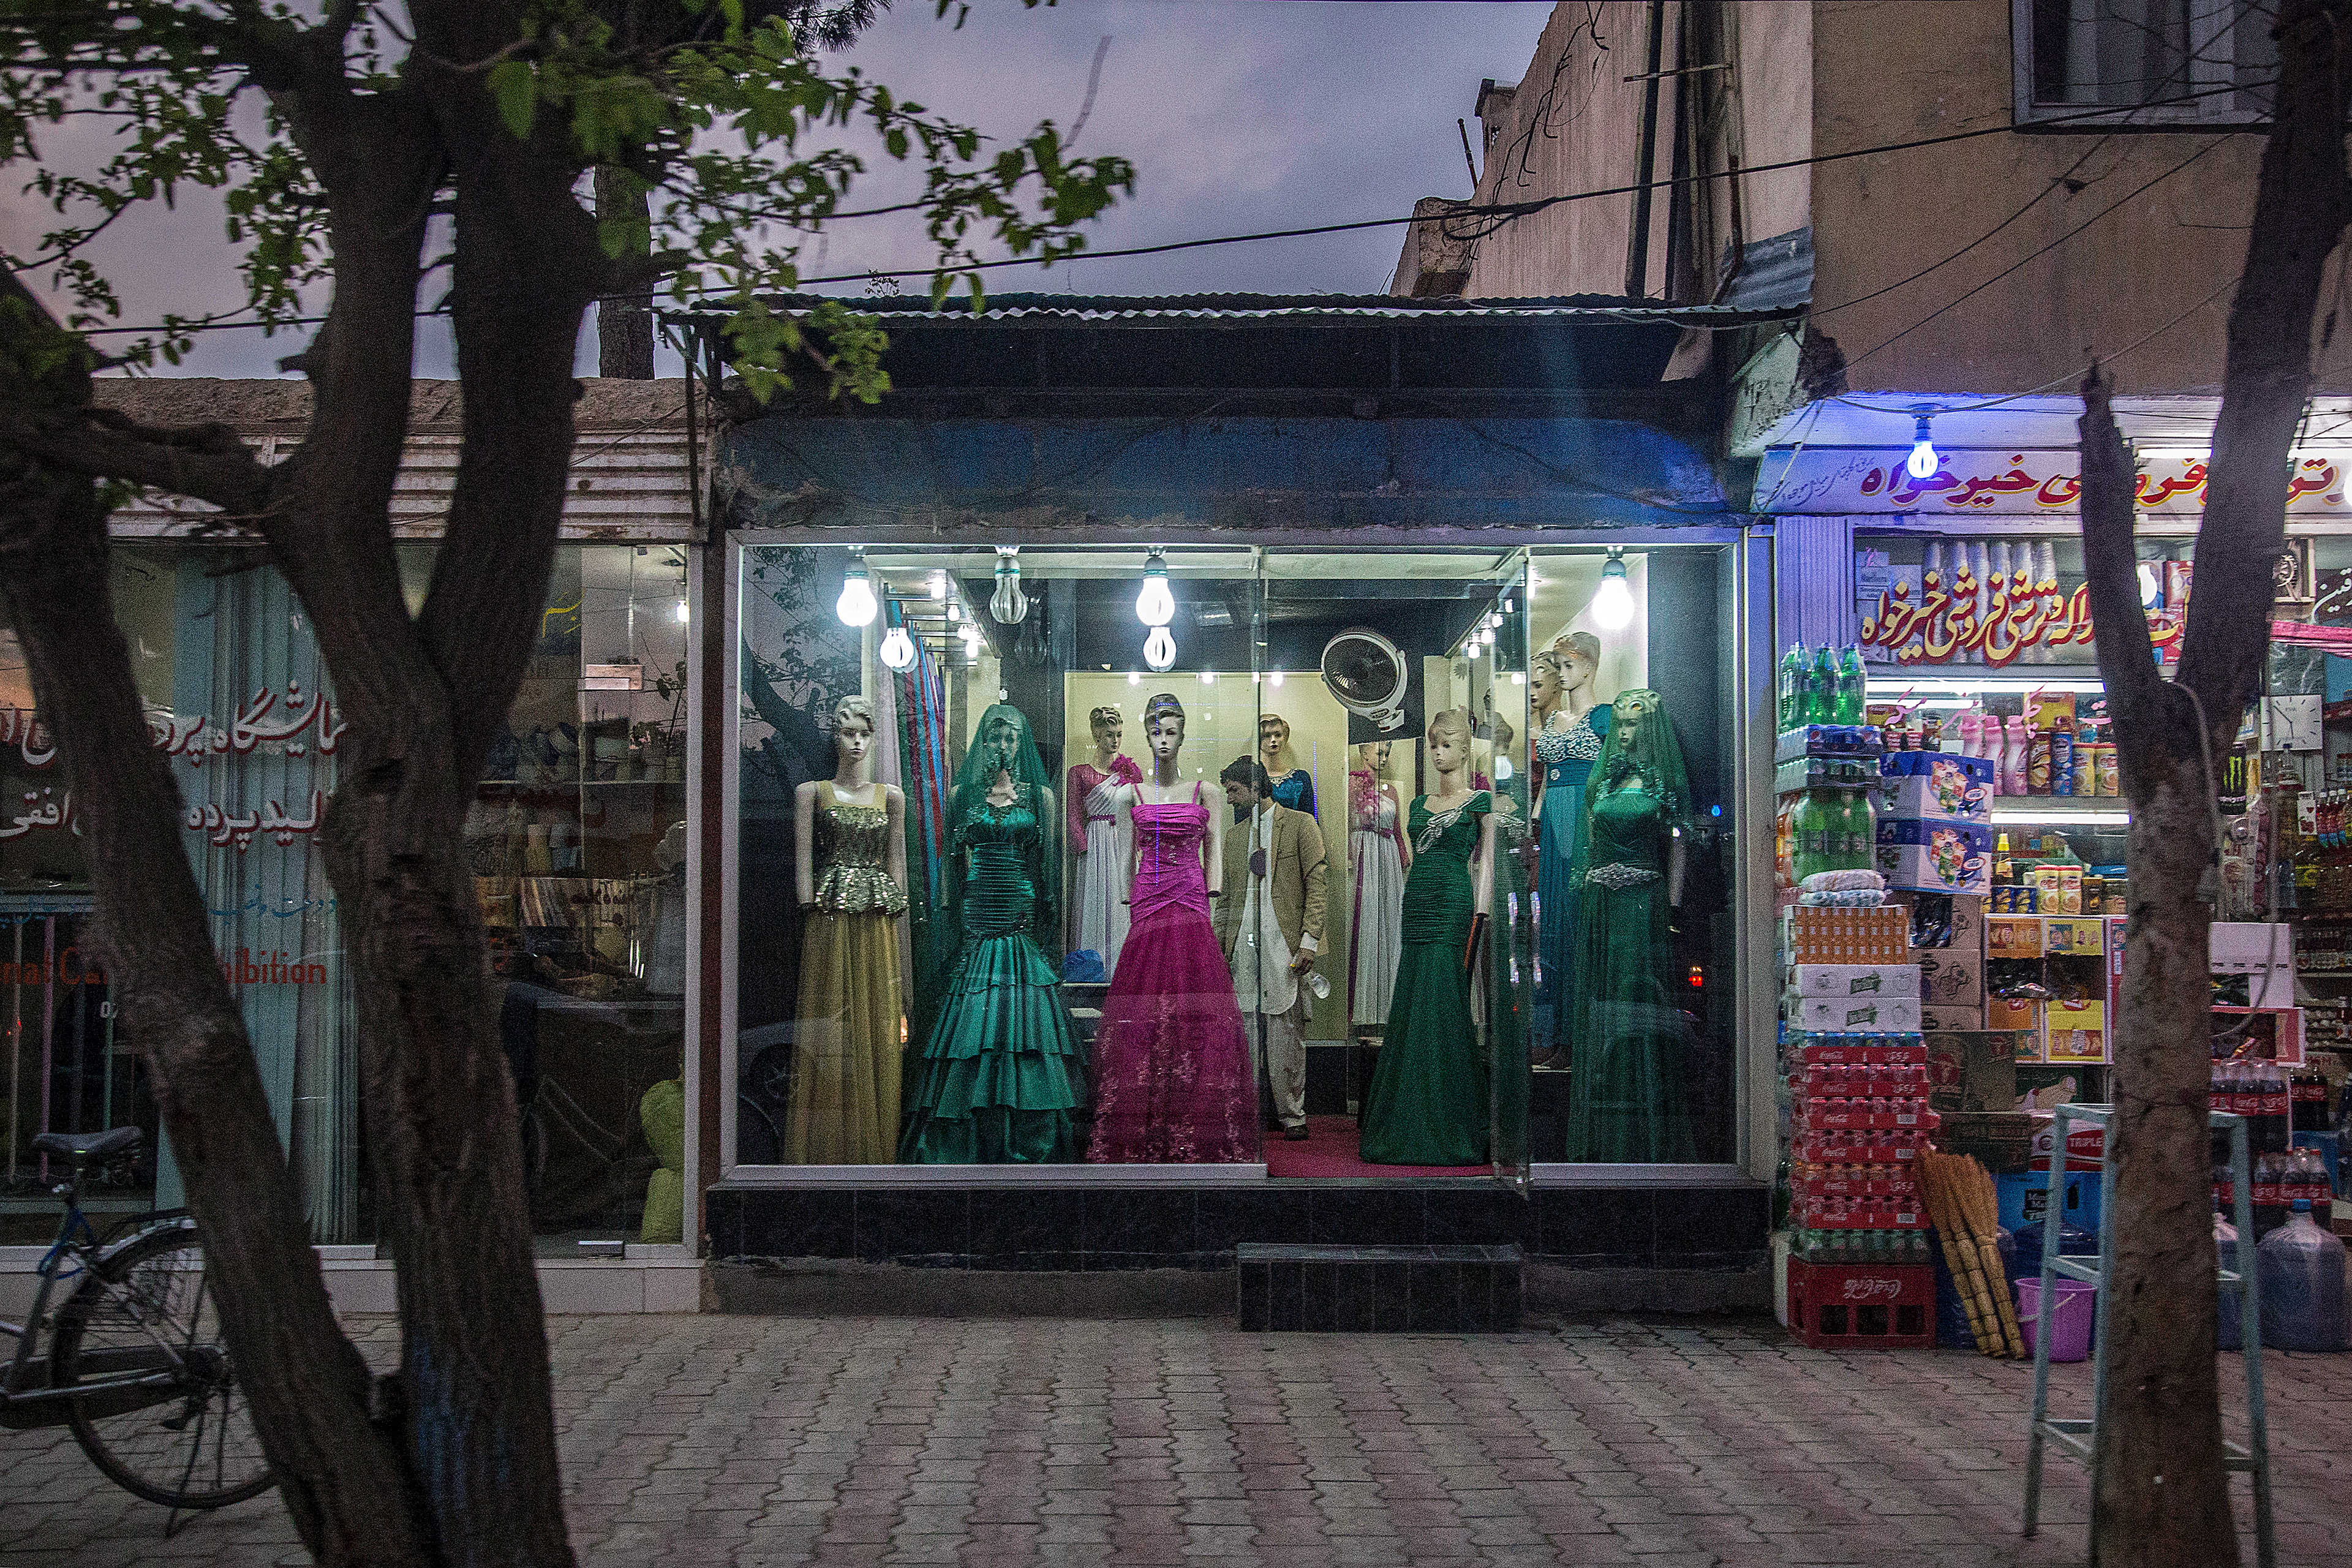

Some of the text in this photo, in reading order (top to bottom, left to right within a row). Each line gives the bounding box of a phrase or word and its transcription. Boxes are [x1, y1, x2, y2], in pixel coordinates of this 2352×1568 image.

[148, 715, 205, 768] پرد
[188, 803, 260, 854] پرده
[0, 948, 52, 985] nal
